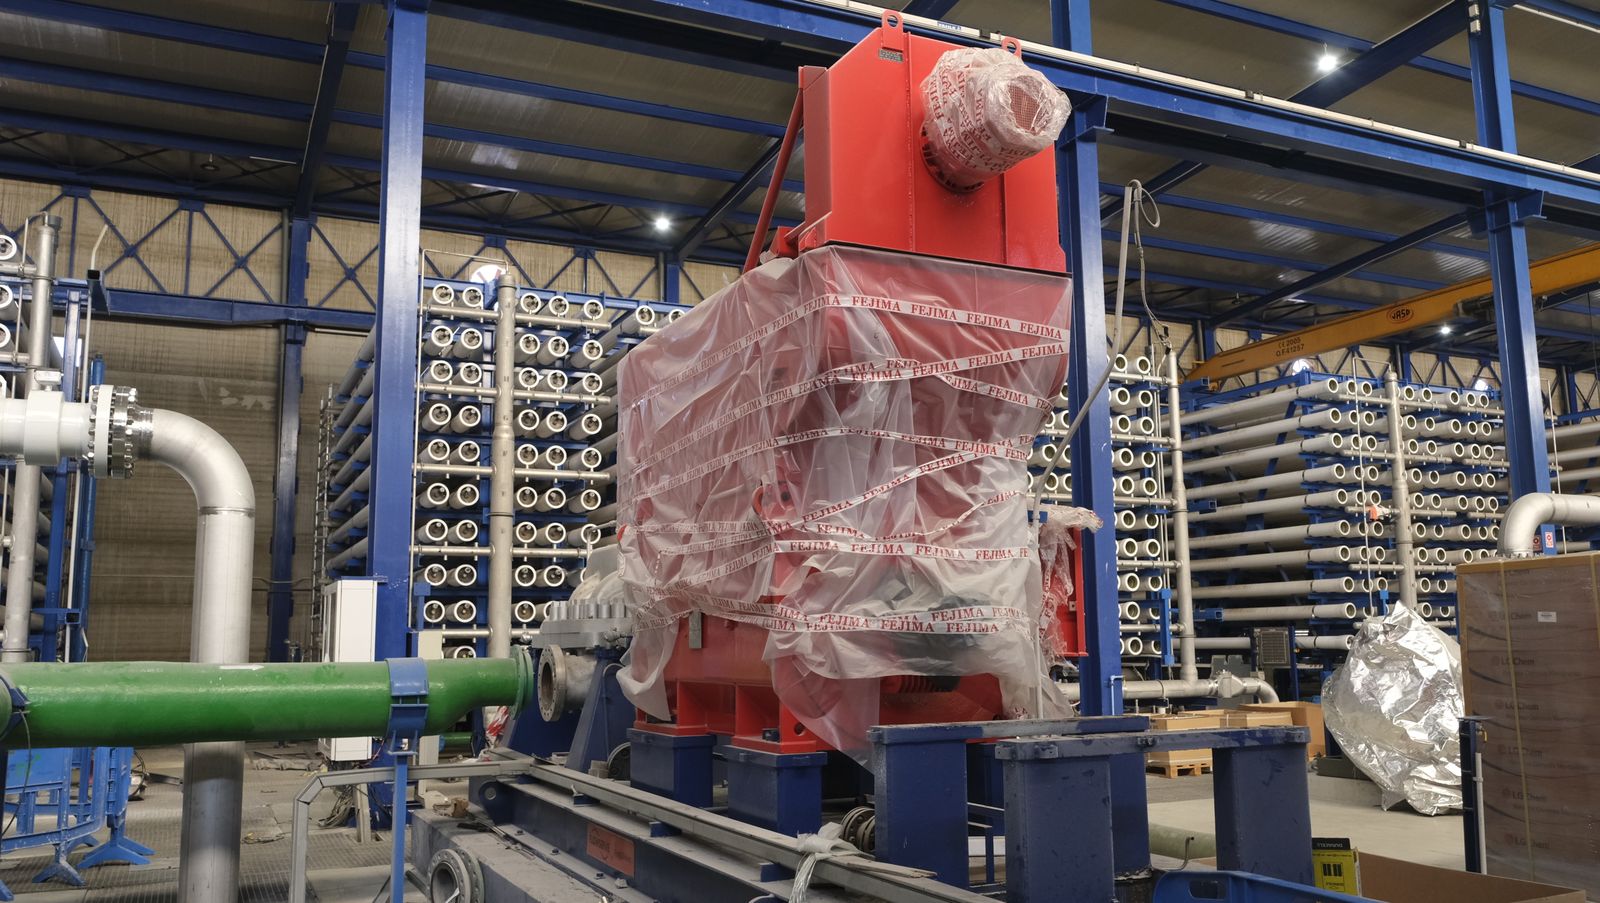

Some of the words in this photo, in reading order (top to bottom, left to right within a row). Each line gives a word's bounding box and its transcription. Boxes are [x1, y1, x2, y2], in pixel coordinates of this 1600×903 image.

[746, 327, 768, 345] FEJIMA
[773, 310, 798, 330] FEJIMA
[804, 296, 840, 314] FEJIMA
[852, 296, 900, 311] FEJIMA
[911, 305, 957, 320] FEJIMA
[967, 313, 1011, 329] FEJIMA
[1020, 323, 1062, 339] FEJIMA
[717, 411, 736, 429] FEJIMA
[739, 399, 761, 416] FEJIMA
[766, 389, 793, 404] FEJIMA
[852, 370, 901, 381] FEJIMA
[913, 361, 959, 376] FEJIMA
[968, 352, 1013, 367] FEJIMA
[1022, 344, 1064, 358] FEJIMA
[946, 376, 978, 391] EJIMA
[989, 387, 1028, 404] FEJIMA
[752, 438, 779, 452] FEJIMA
[955, 441, 997, 455] FEJIMA
[803, 501, 852, 523] FEJIMA
[919, 454, 965, 473] FEJIMA
[725, 555, 748, 572] FEJIMA
[752, 543, 781, 561] FEJIMA
[790, 542, 839, 551] FEJIMA
[851, 543, 904, 553] FEJIMA
[915, 545, 964, 559] FEJIMA
[976, 550, 1014, 559] FEJIMA
[771, 605, 808, 621] FEJIMA
[819, 614, 870, 627] FEJIMA
[932, 608, 984, 622] FEJIMA
[881, 620, 934, 632] FEJIMA
[946, 623, 999, 632] FEJIMA
